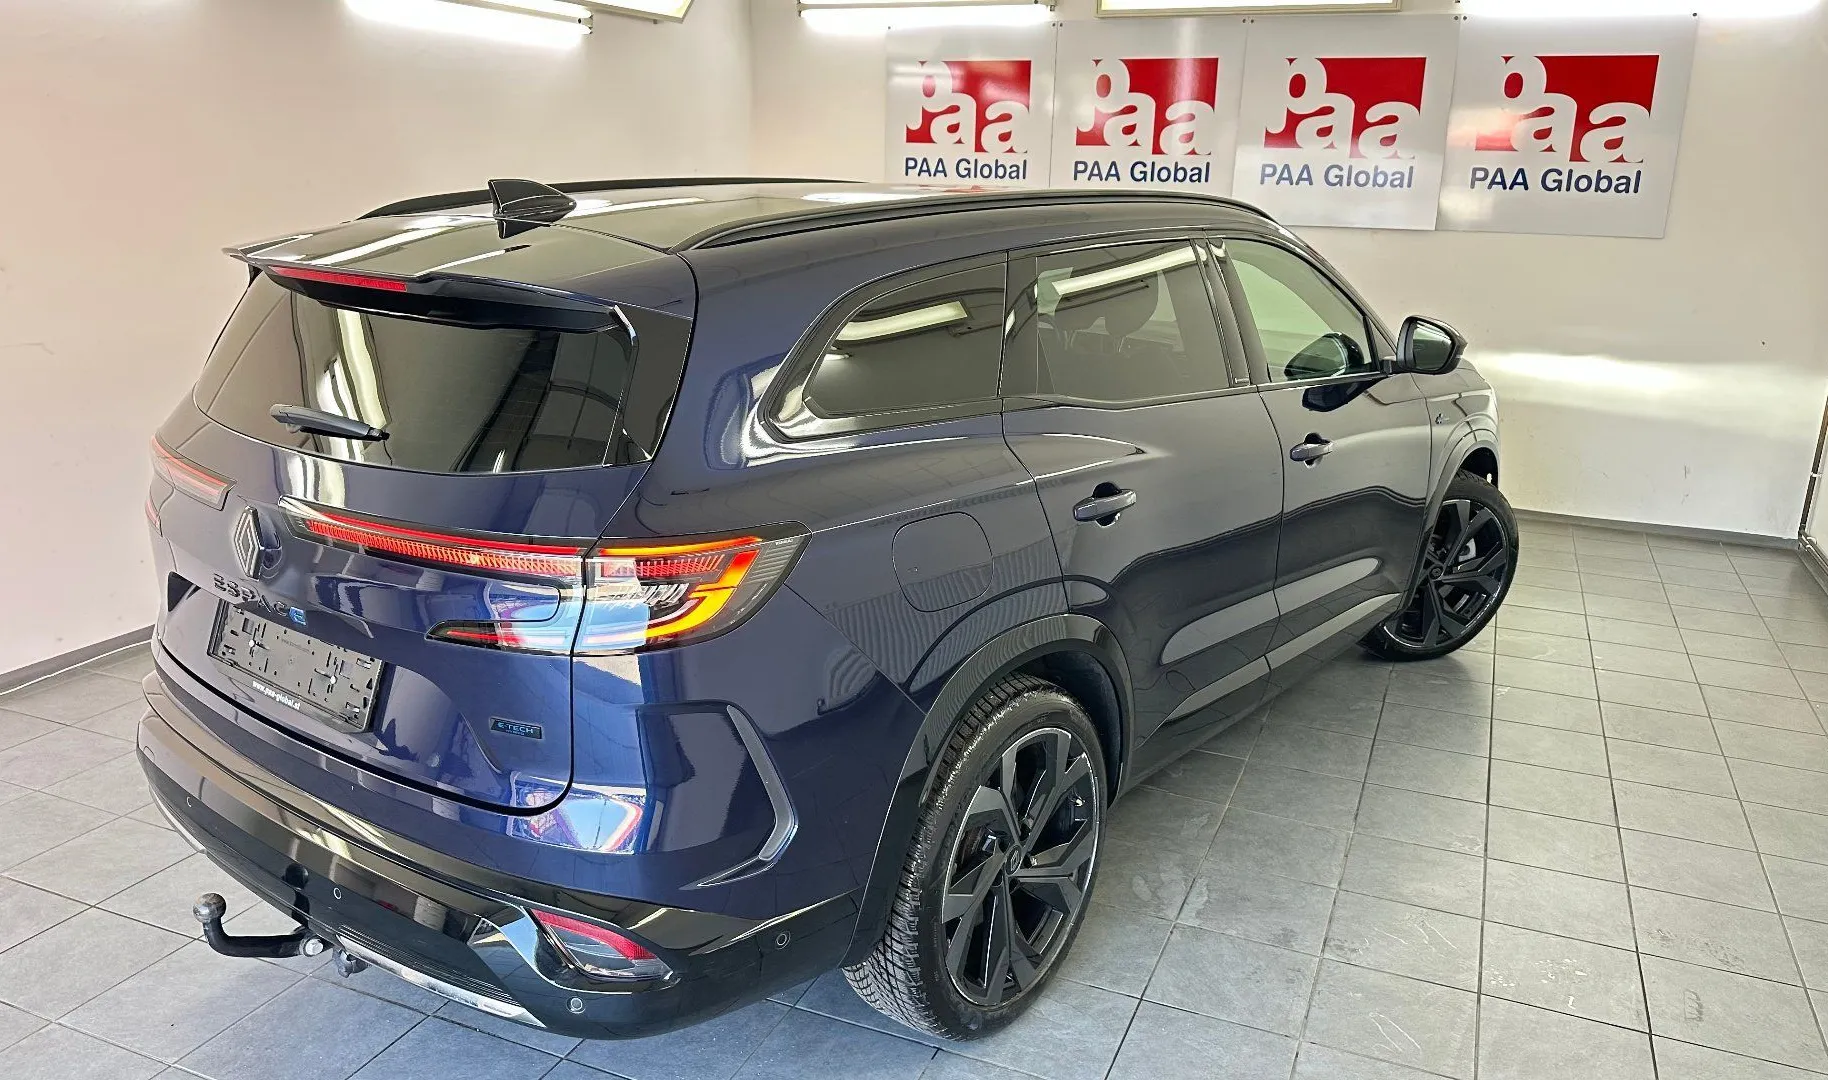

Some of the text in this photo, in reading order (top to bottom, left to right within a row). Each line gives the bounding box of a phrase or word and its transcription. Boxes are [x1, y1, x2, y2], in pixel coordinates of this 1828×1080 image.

[904, 157, 1028, 181] PAA Global
[1073, 160, 1211, 184] PAA Global
[1260, 163, 1415, 189] PAA Global
[1469, 166, 1643, 194] PAA Global
